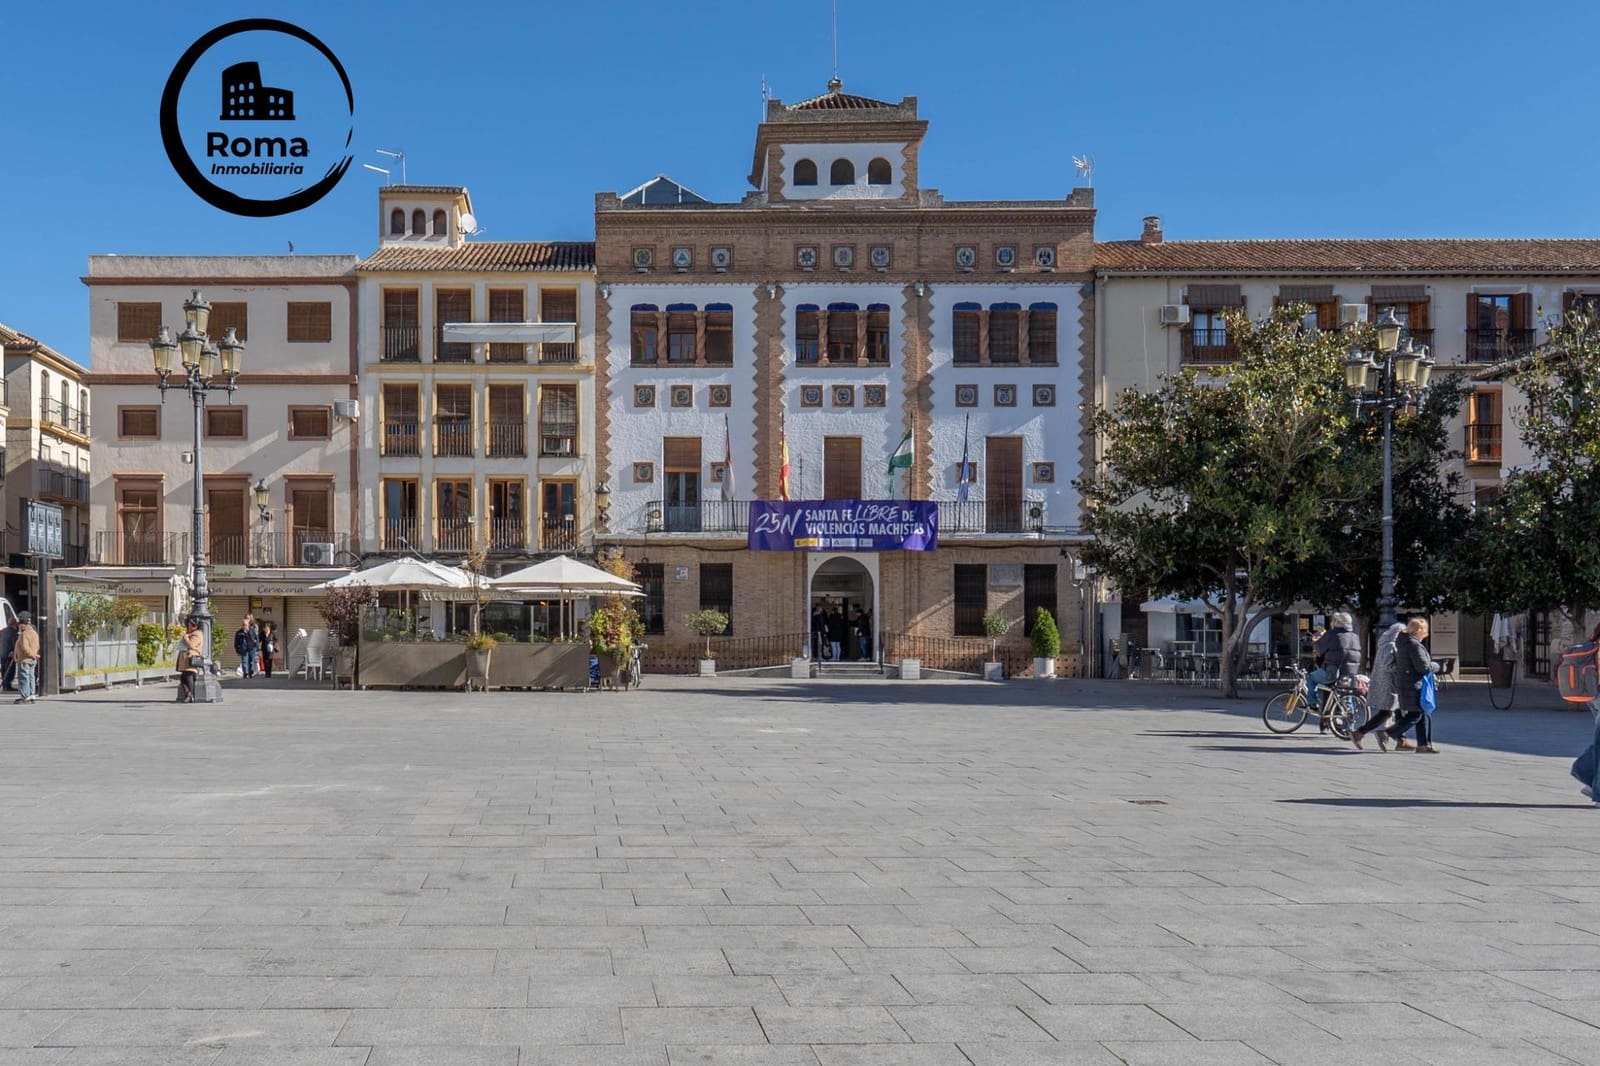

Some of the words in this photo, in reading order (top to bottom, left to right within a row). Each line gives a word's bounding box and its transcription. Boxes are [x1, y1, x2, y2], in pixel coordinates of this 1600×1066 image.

[805, 509, 838, 521] SANTA
[841, 509, 852, 522] FE
[902, 510, 914, 522] DE
[755, 509, 802, 536] 25N
[805, 522, 865, 535] VIOLENCIAS
